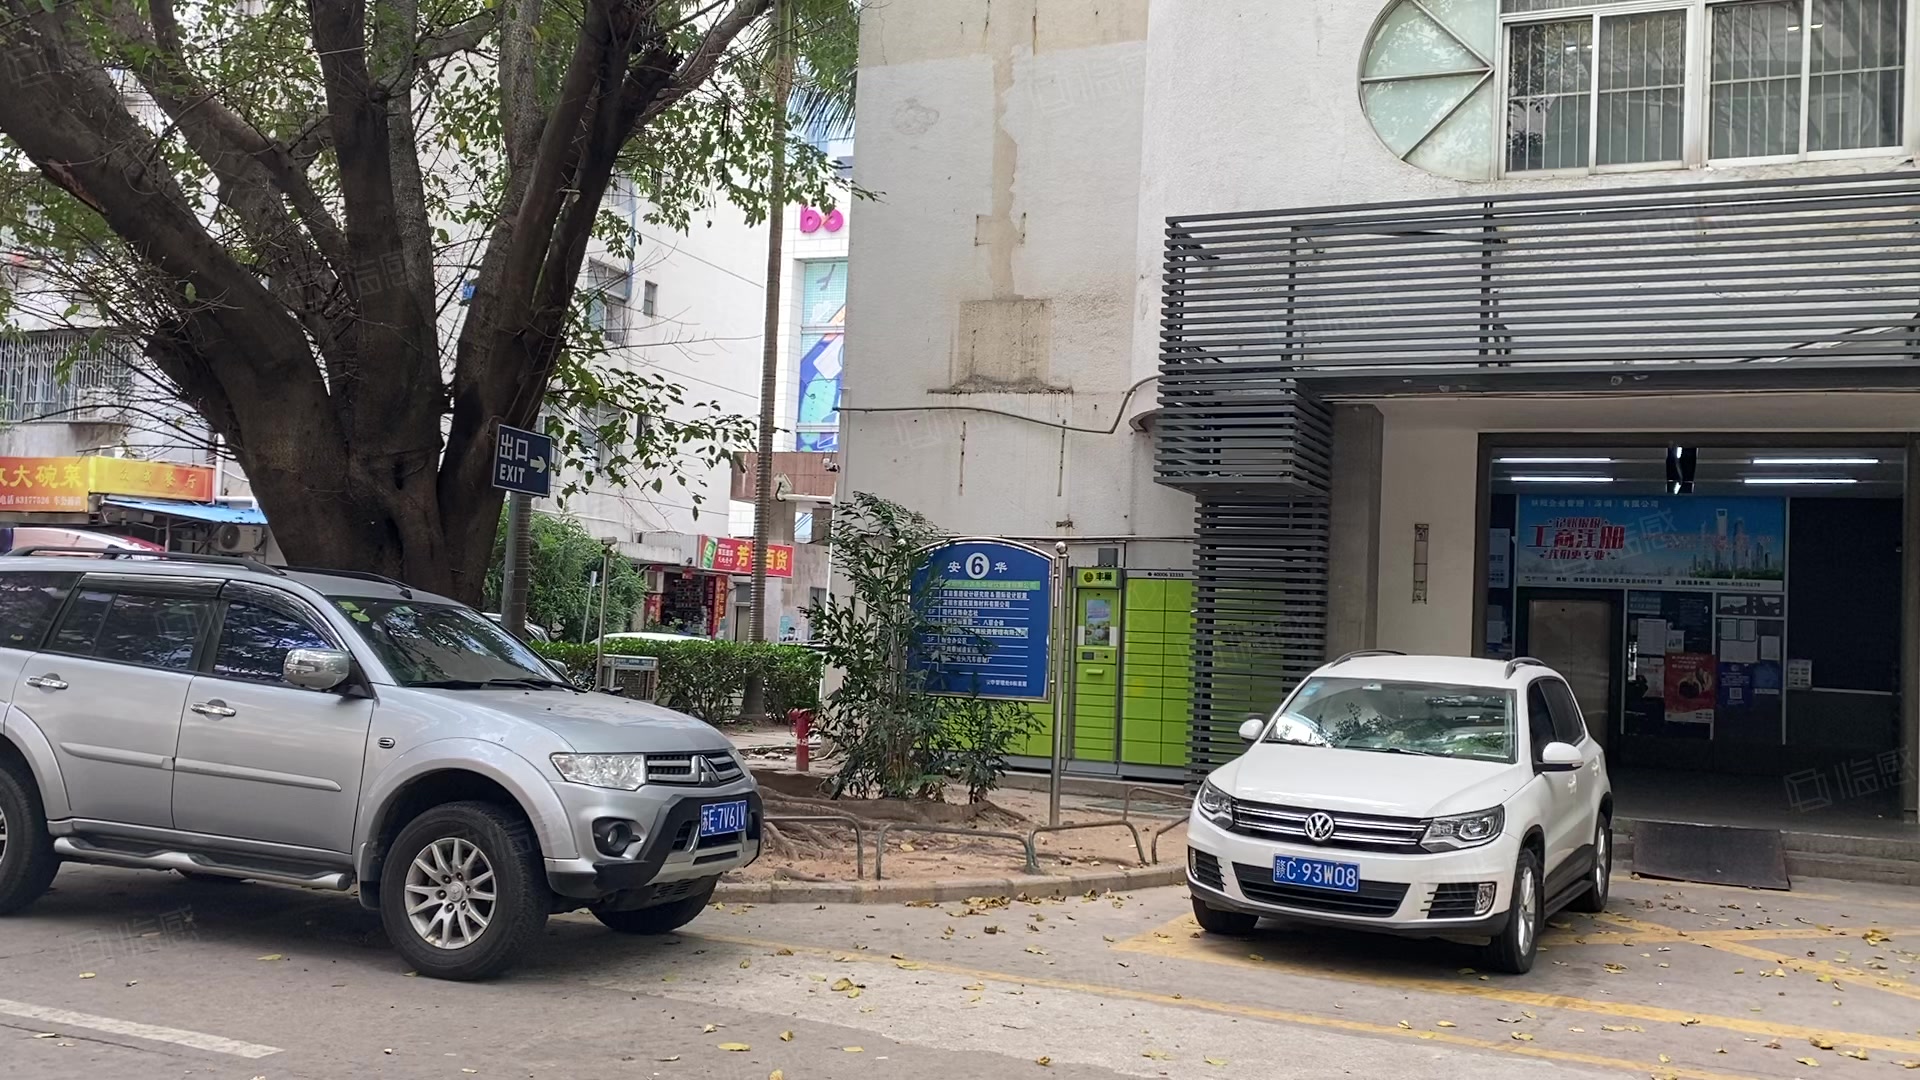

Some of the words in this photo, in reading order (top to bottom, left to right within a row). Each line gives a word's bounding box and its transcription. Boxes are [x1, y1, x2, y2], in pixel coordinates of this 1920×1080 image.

[499, 434, 528, 462] 出口
[499, 463, 526, 484] EXIT
[1525, 525, 1626, 550] 工商注册
[736, 544, 789, 571] 芳百货
[947, 560, 961, 573] 安
[971, 557, 984, 576] 6
[994, 561, 1008, 574] 华
[1547, 549, 1606, 561] 我们更专业
